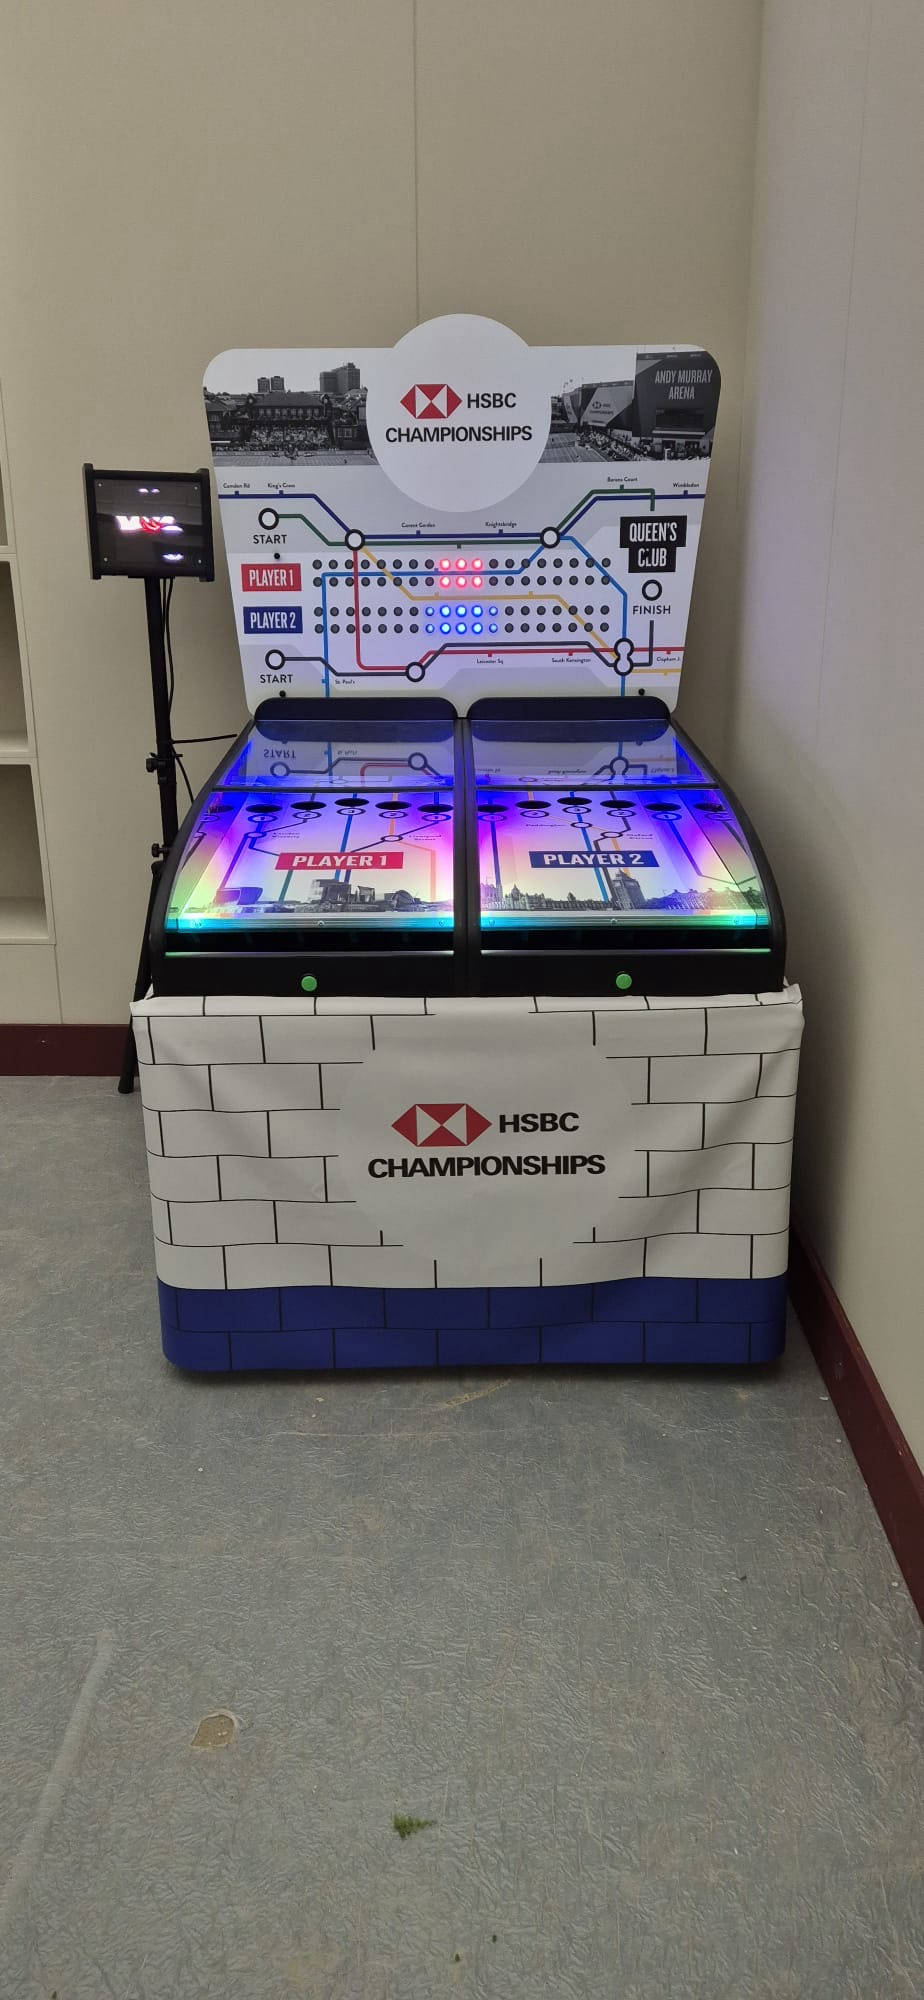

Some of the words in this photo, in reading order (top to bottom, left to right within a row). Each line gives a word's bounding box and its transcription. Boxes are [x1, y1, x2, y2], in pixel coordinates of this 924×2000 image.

[655, 370, 677, 384] ANDY
[677, 369, 713, 384] MURRAY
[466, 392, 518, 409] HSBC
[668, 386, 695, 400] ARENA
[385, 425, 533, 443] CHAMPIONSHIPS
[253, 534, 287, 545] START
[629, 522, 678, 543] QUEEN'S
[637, 547, 667, 568] CLUB
[249, 569, 288, 587] PLAYER
[289, 569, 294, 586] 1
[632, 605, 671, 615] FINISH
[250, 612, 288, 629] PLAYER
[289, 612, 297, 628] 2
[260, 674, 294, 684] START
[292, 855, 373, 867] PLAYER
[379, 855, 387, 866] 1
[543, 854, 625, 865] PLAYER
[631, 854, 645, 865] 2
[499, 1112, 580, 1133] HSBC
[367, 1154, 606, 1178] CHAMPIONSHIPS
